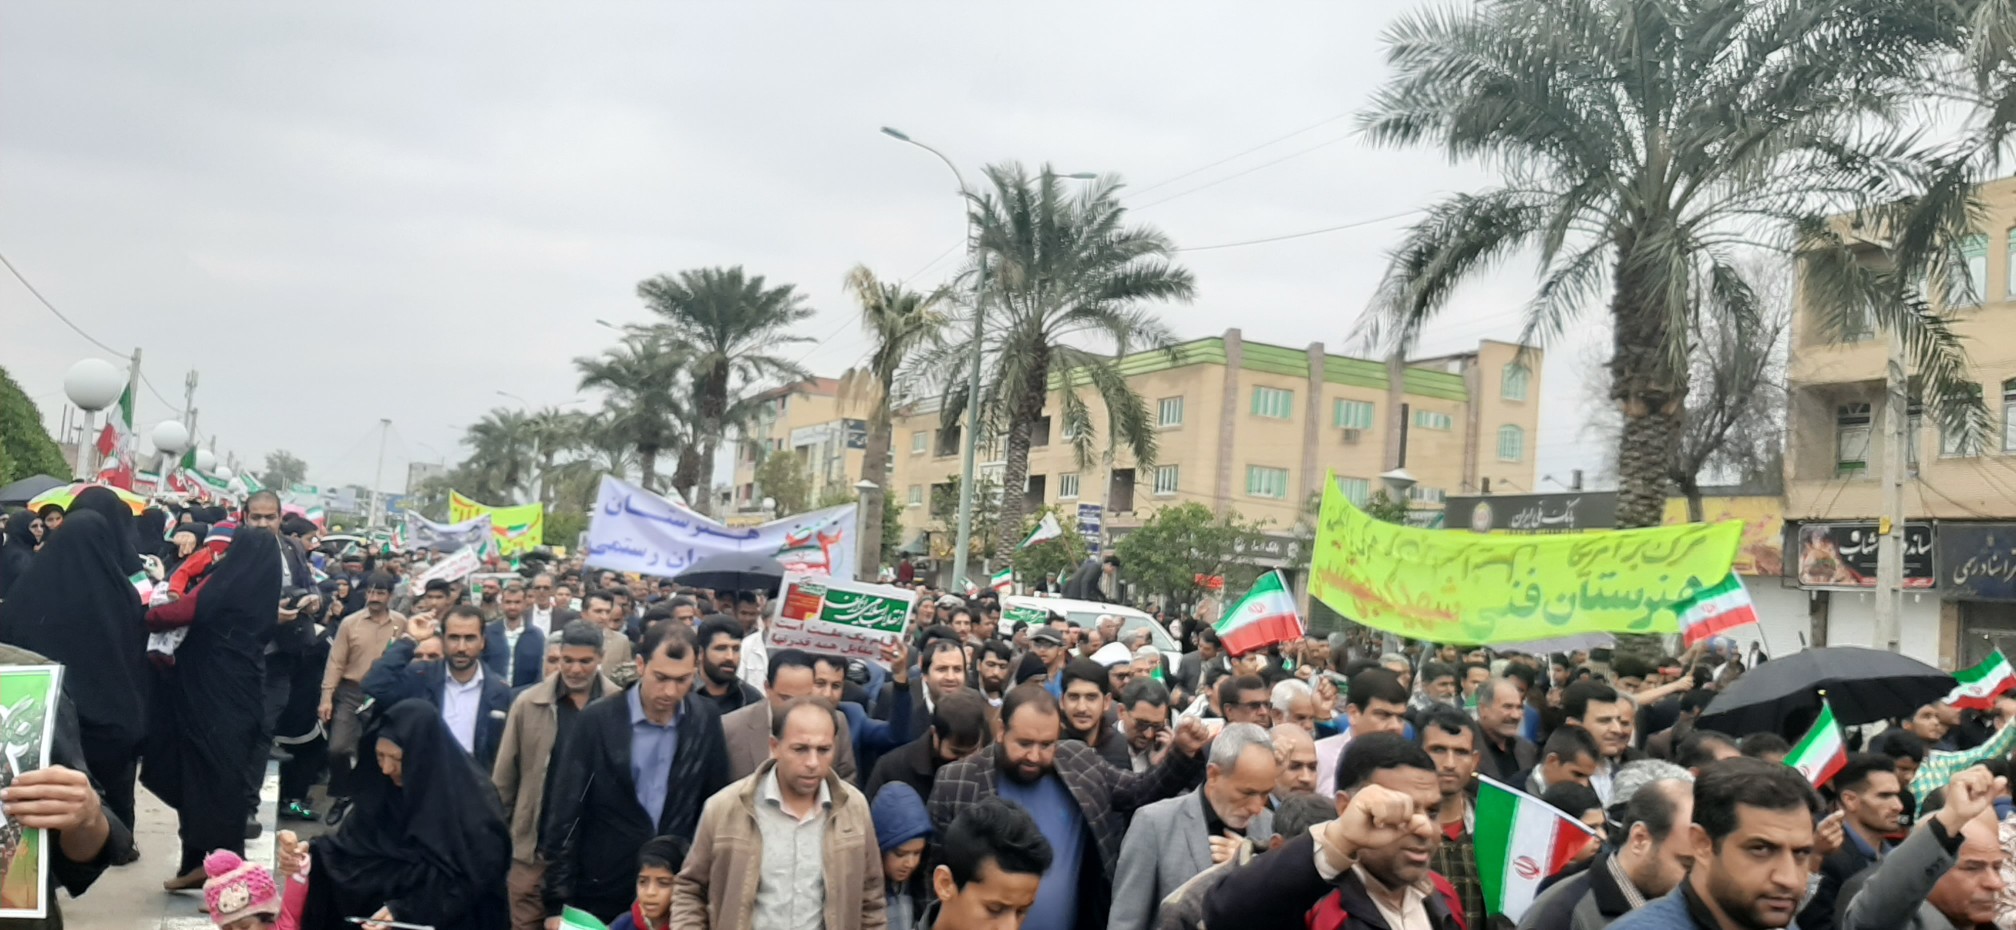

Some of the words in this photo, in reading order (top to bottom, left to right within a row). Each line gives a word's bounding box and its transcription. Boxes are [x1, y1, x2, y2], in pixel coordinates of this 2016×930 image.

[603, 494, 761, 541] هنرستان
[1510, 507, 1535, 529] ایران
[1542, 497, 1581, 528] بانک
[1641, 525, 1708, 567] مرگ
[1460, 565, 1542, 640] فنی
[1542, 571, 1704, 630] هنرستان
